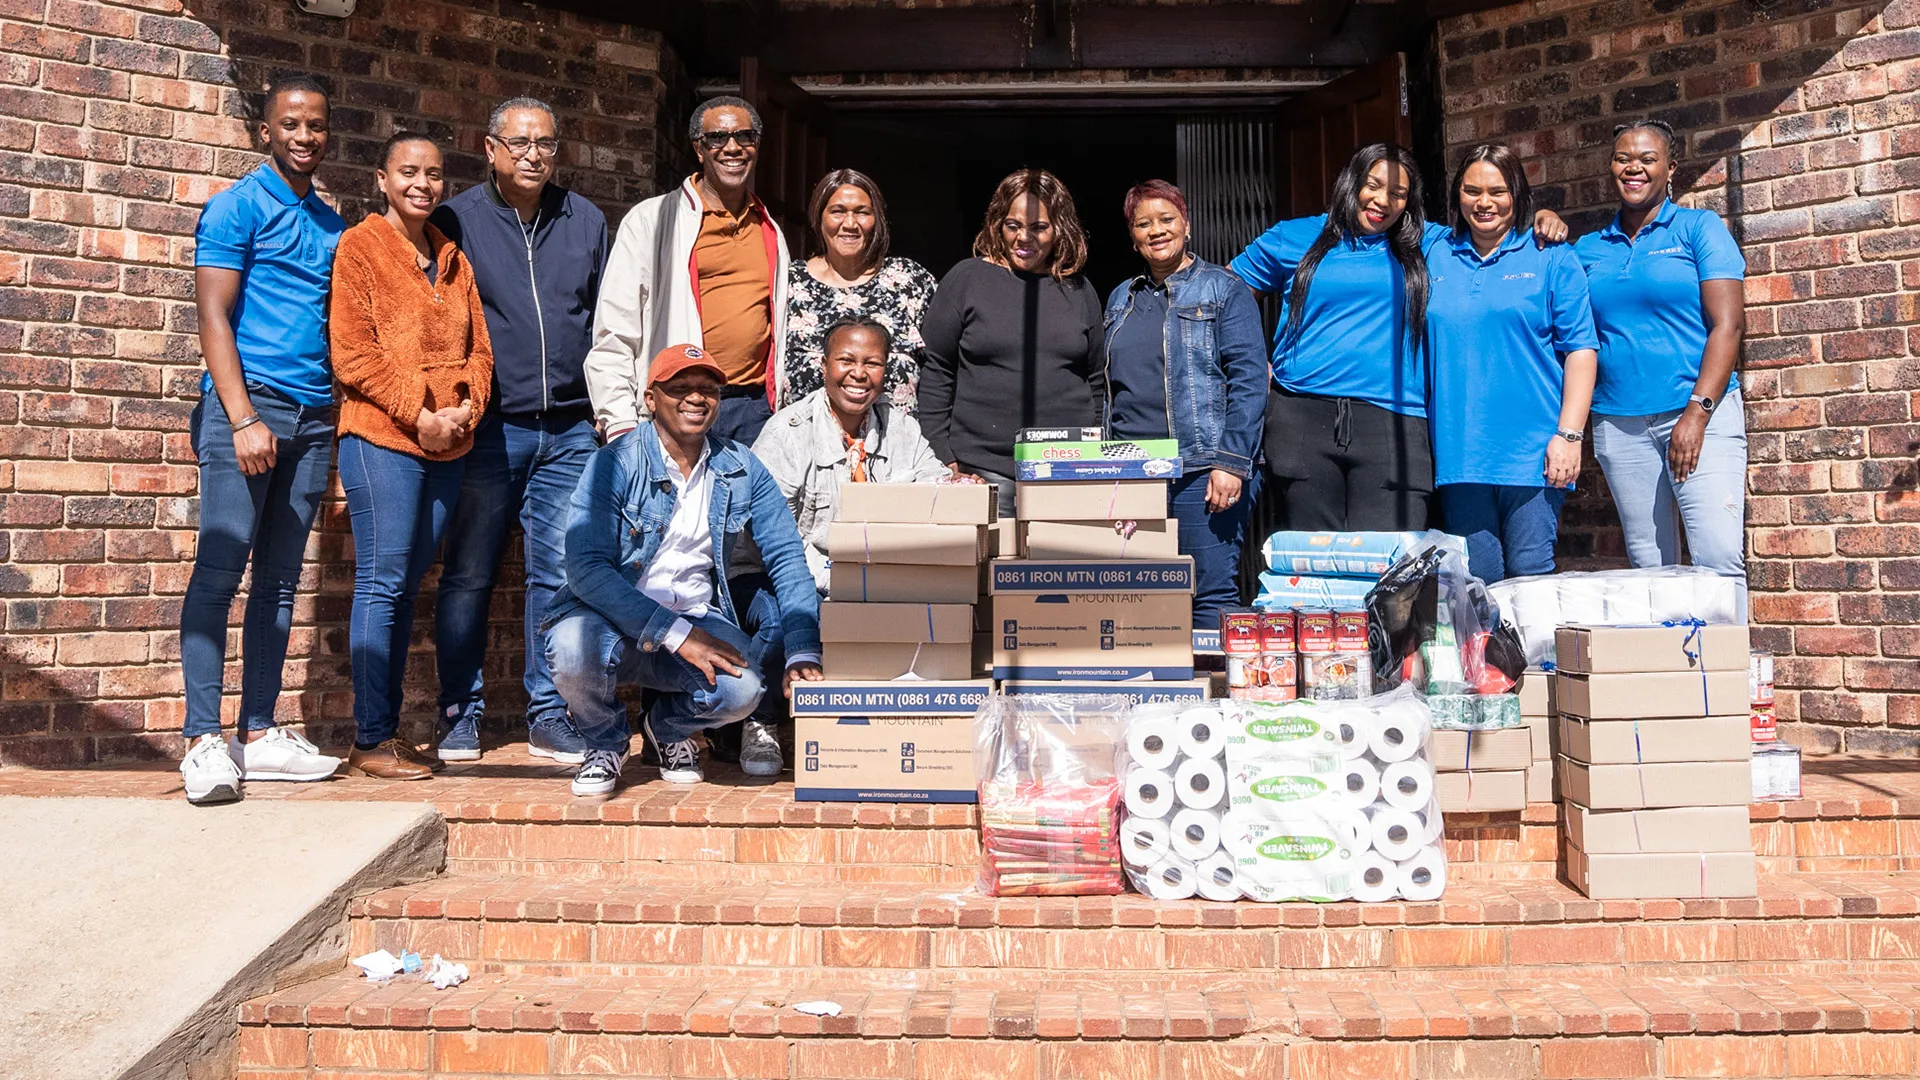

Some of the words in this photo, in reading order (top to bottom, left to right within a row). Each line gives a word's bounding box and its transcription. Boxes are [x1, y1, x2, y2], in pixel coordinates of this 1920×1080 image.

[1026, 430, 1069, 440] DOMINOES
[1042, 446, 1081, 459] chess
[997, 571, 1026, 584] 0861
[1030, 571, 1063, 583] IRON
[1066, 571, 1095, 583] MTN
[1099, 570, 1132, 585] (0861
[1135, 571, 1158, 583] 476
[1161, 570, 1188, 585] 668)
[797, 693, 826, 706] 0861
[829, 693, 862, 706] IRON
[865, 693, 894, 706] MTN
[897, 692, 930, 709] (0861
[934, 693, 957, 706] 476
[1147, 693, 1171, 705] 476
[1251, 724, 1314, 735] TWINSAVER
[857, 791, 929, 799] www.ironmountain.co.za
[1257, 782, 1321, 795] TWINSAVER
[1263, 842, 1330, 855] TWINSAVER
